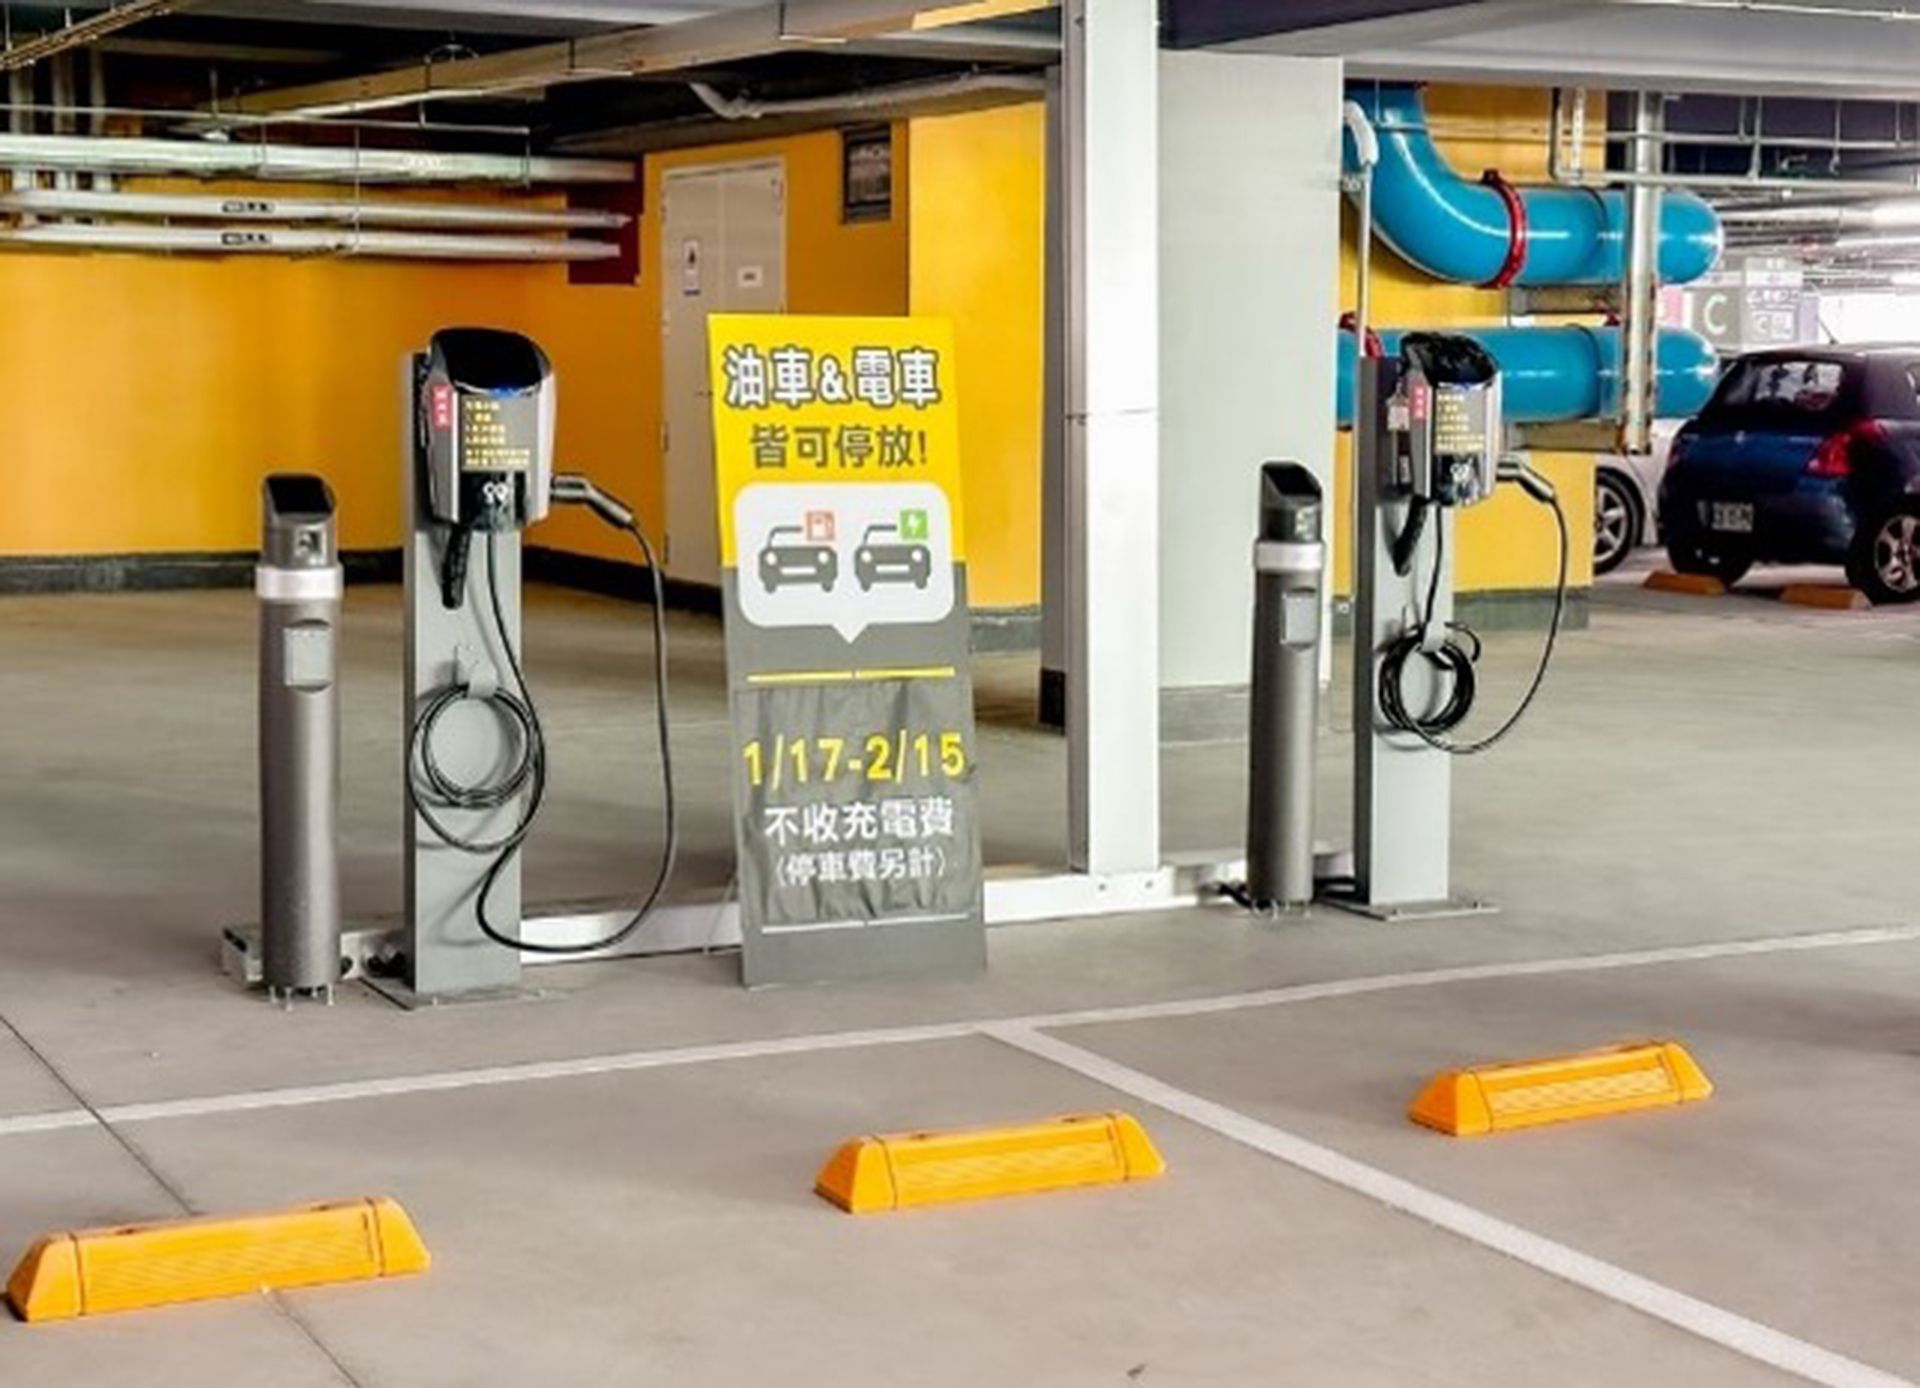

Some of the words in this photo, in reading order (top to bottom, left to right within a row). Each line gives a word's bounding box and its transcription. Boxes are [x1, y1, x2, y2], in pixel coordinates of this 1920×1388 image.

[1703, 293, 1727, 336] C
[723, 343, 941, 408] 油車&電車
[750, 424, 927, 468] 皆可停放!
[743, 729, 966, 791] 1/17-2/15
[764, 797, 954, 847] 不收充電費
[776, 847, 946, 887] (停車費另計)
